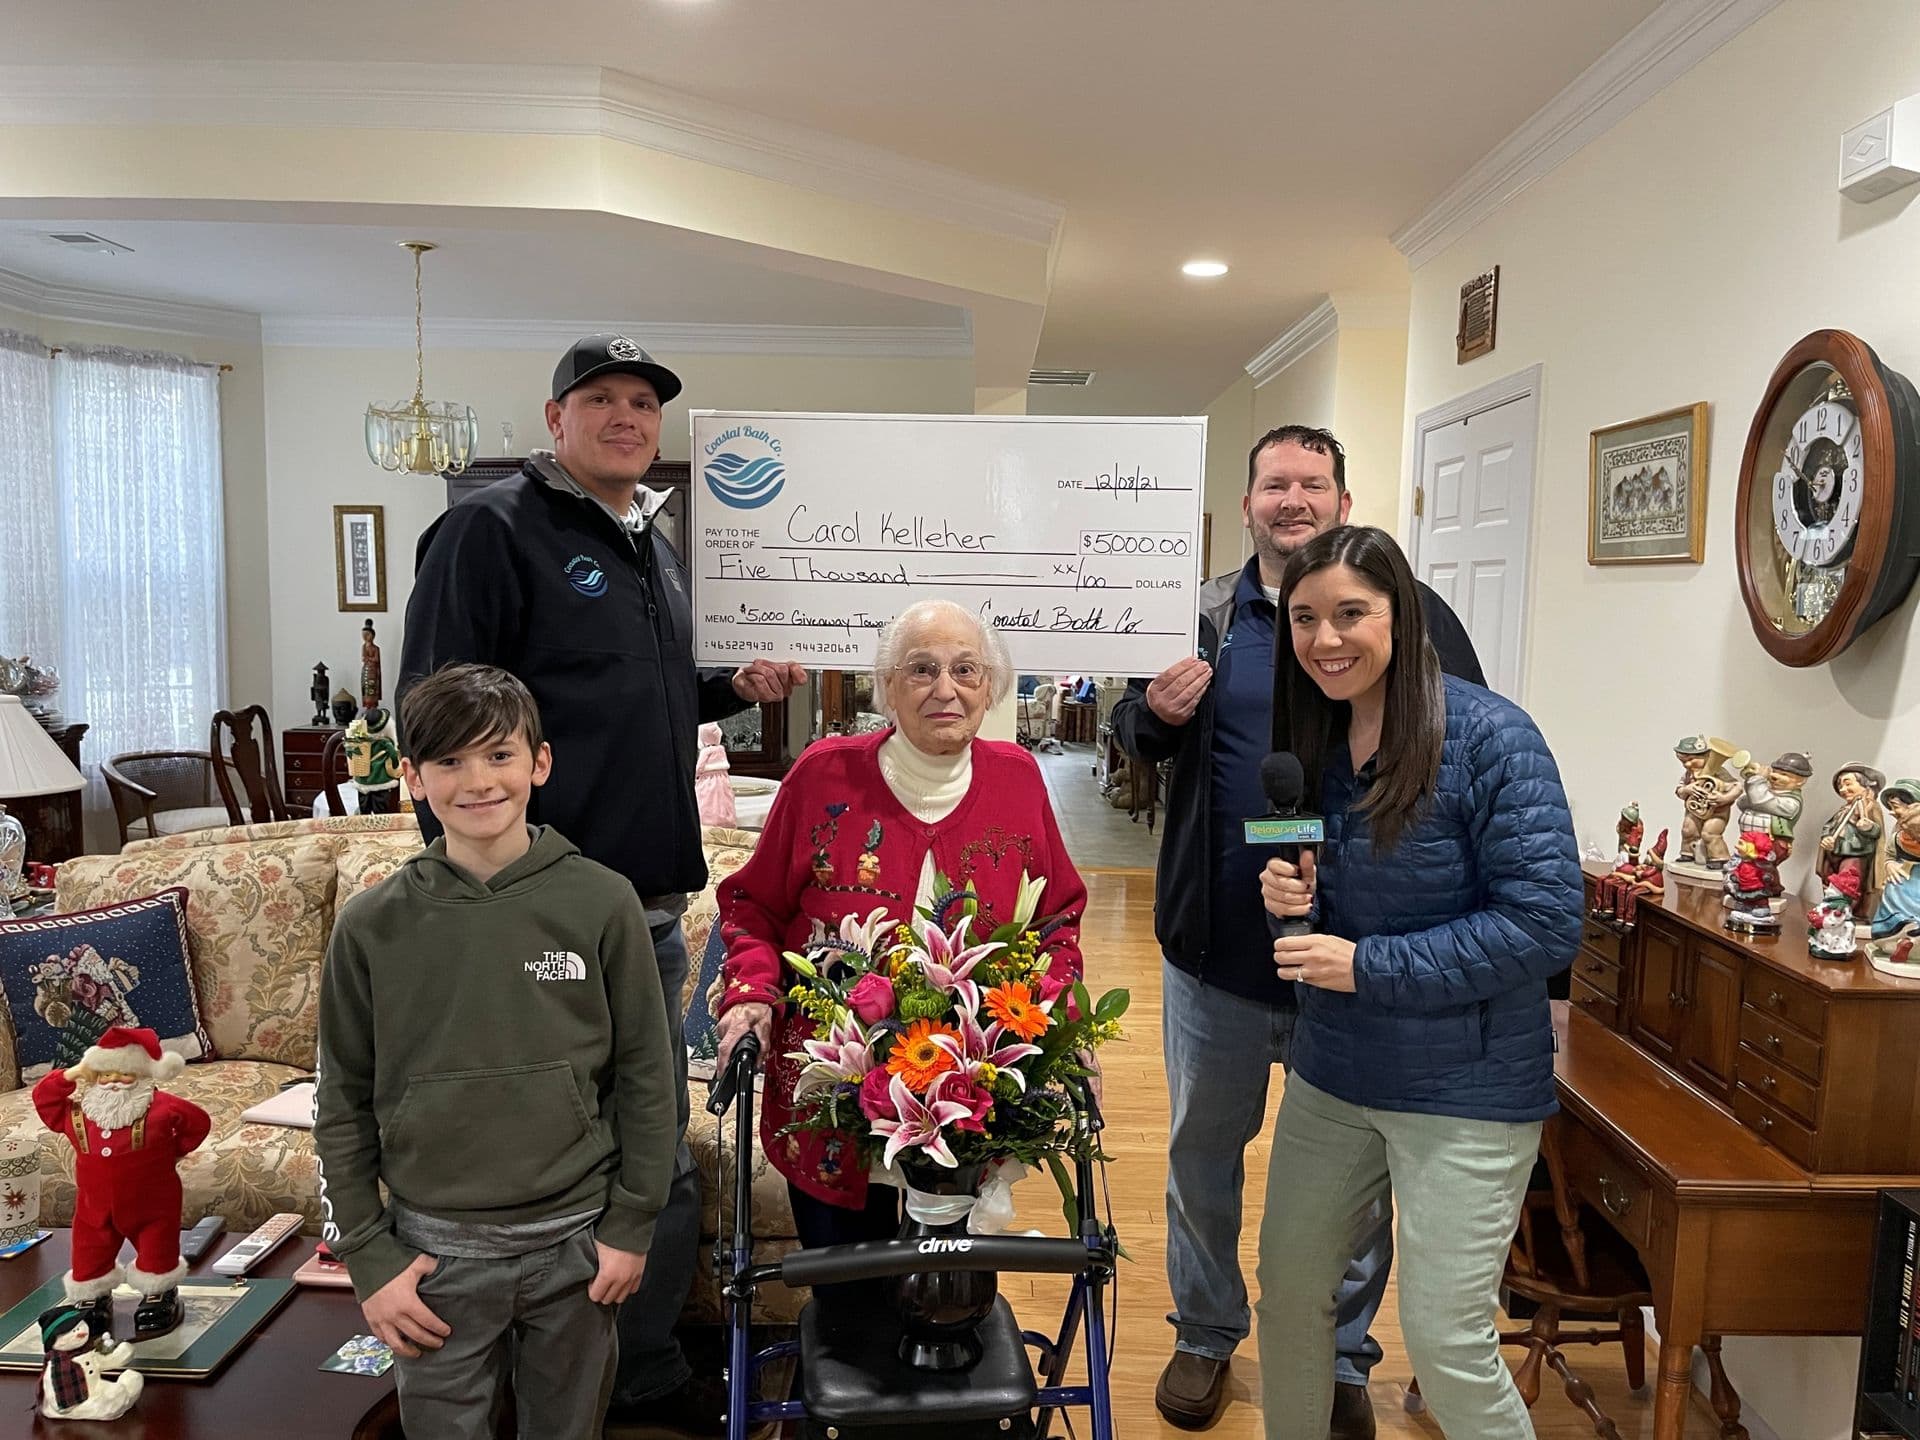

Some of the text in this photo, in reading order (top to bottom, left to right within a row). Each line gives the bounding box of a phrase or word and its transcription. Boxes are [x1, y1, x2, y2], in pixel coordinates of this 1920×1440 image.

[1816, 407, 1828, 432] 12
[704, 425, 782, 457] Coastal Bath Co.
[1799, 420, 1807, 443] 11
[1852, 434, 1860, 459] 2
[1057, 479, 1083, 489] DATE
[1095, 462, 1159, 503] 12/08/21
[1778, 477, 1786, 500] 9
[1849, 468, 1858, 493] 3
[1780, 509, 1788, 531] 8
[1841, 501, 1850, 528] 4
[705, 528, 760, 539] PAY TO THE
[787, 504, 996, 551] Carol Kelleher
[705, 540, 756, 549] ORDER OF
[1792, 530, 1800, 553] 7
[1813, 538, 1821, 560] 6
[1827, 529, 1835, 553] 5
[719, 553, 771, 579] Five
[779, 556, 910, 586] Thousand
[1135, 579, 1182, 589] DOLLARS
[705, 614, 735, 624] MEMO
[739, 603, 785, 623] $5,000
[791, 609, 851, 637] Giveaway
[524, 961, 566, 971] NORTH
[543, 951, 566, 962] THE
[536, 970, 566, 981] FACE
[918, 1237, 973, 1254] drive
